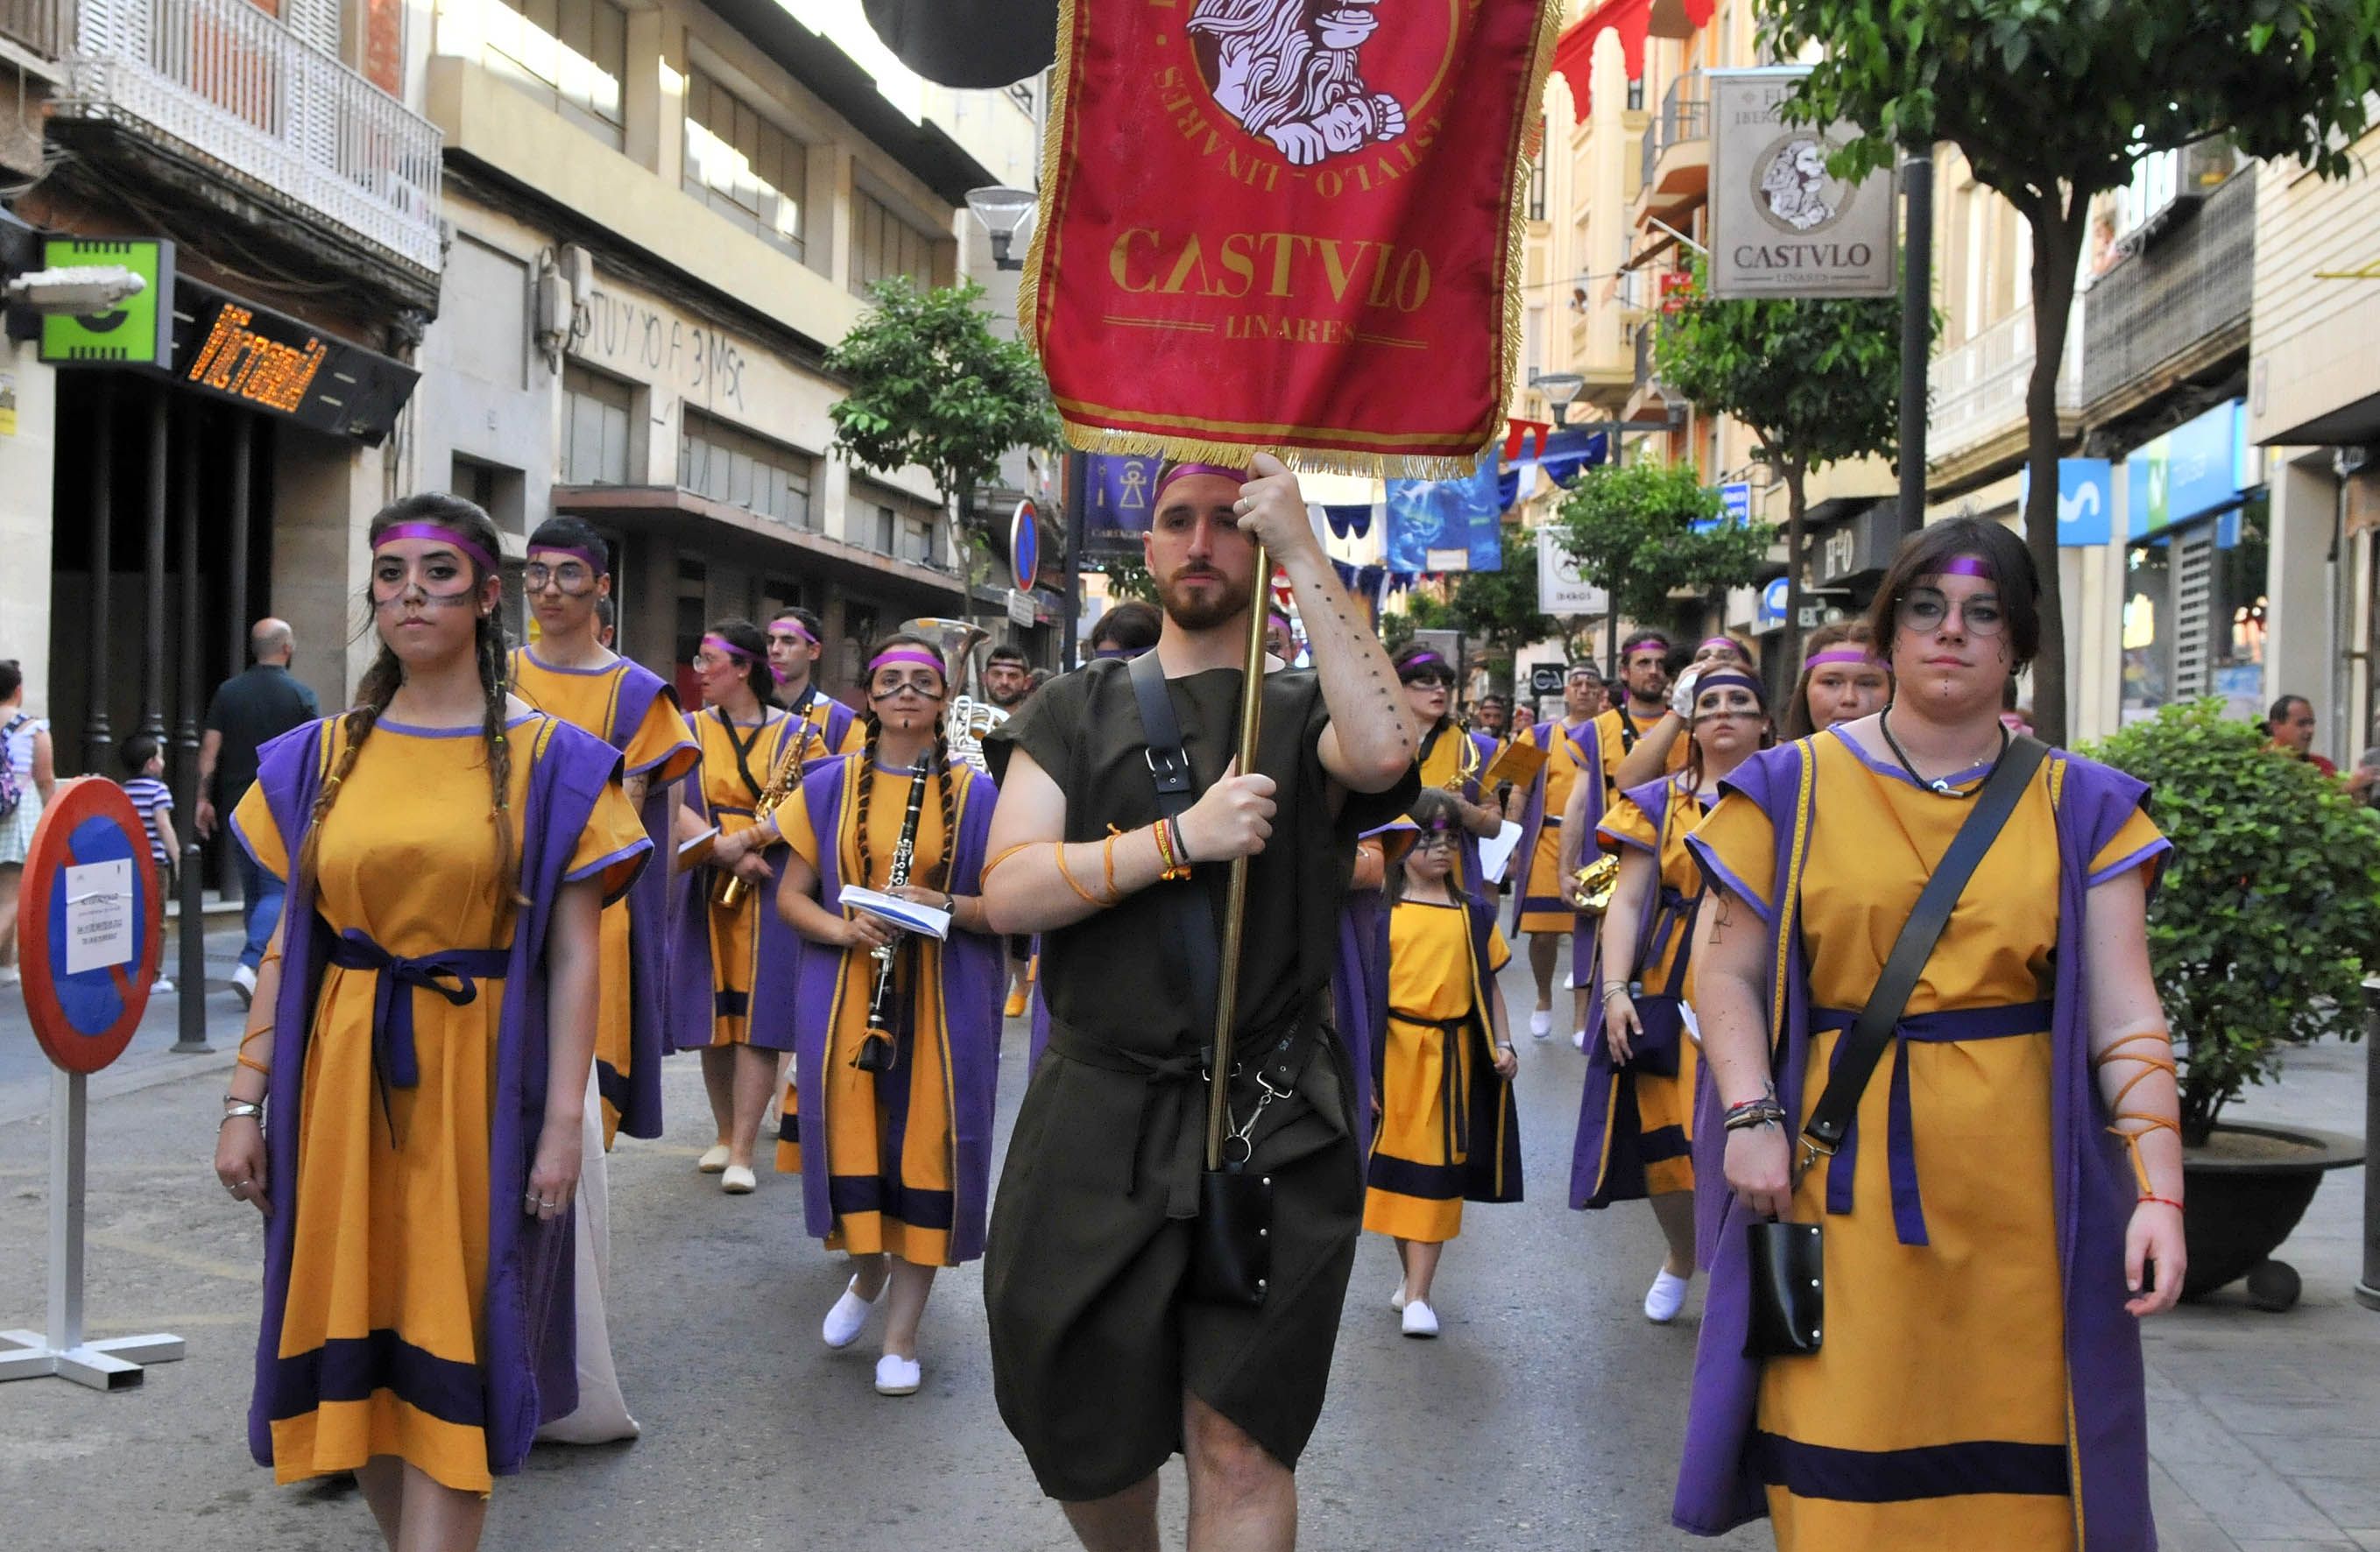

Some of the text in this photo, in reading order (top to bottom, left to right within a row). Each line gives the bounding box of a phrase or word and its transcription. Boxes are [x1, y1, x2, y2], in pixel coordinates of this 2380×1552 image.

[1108, 228, 1431, 313] CASTVLO
[1734, 243, 1871, 269] CASTVLO
[1225, 314, 1357, 344] LINARES
